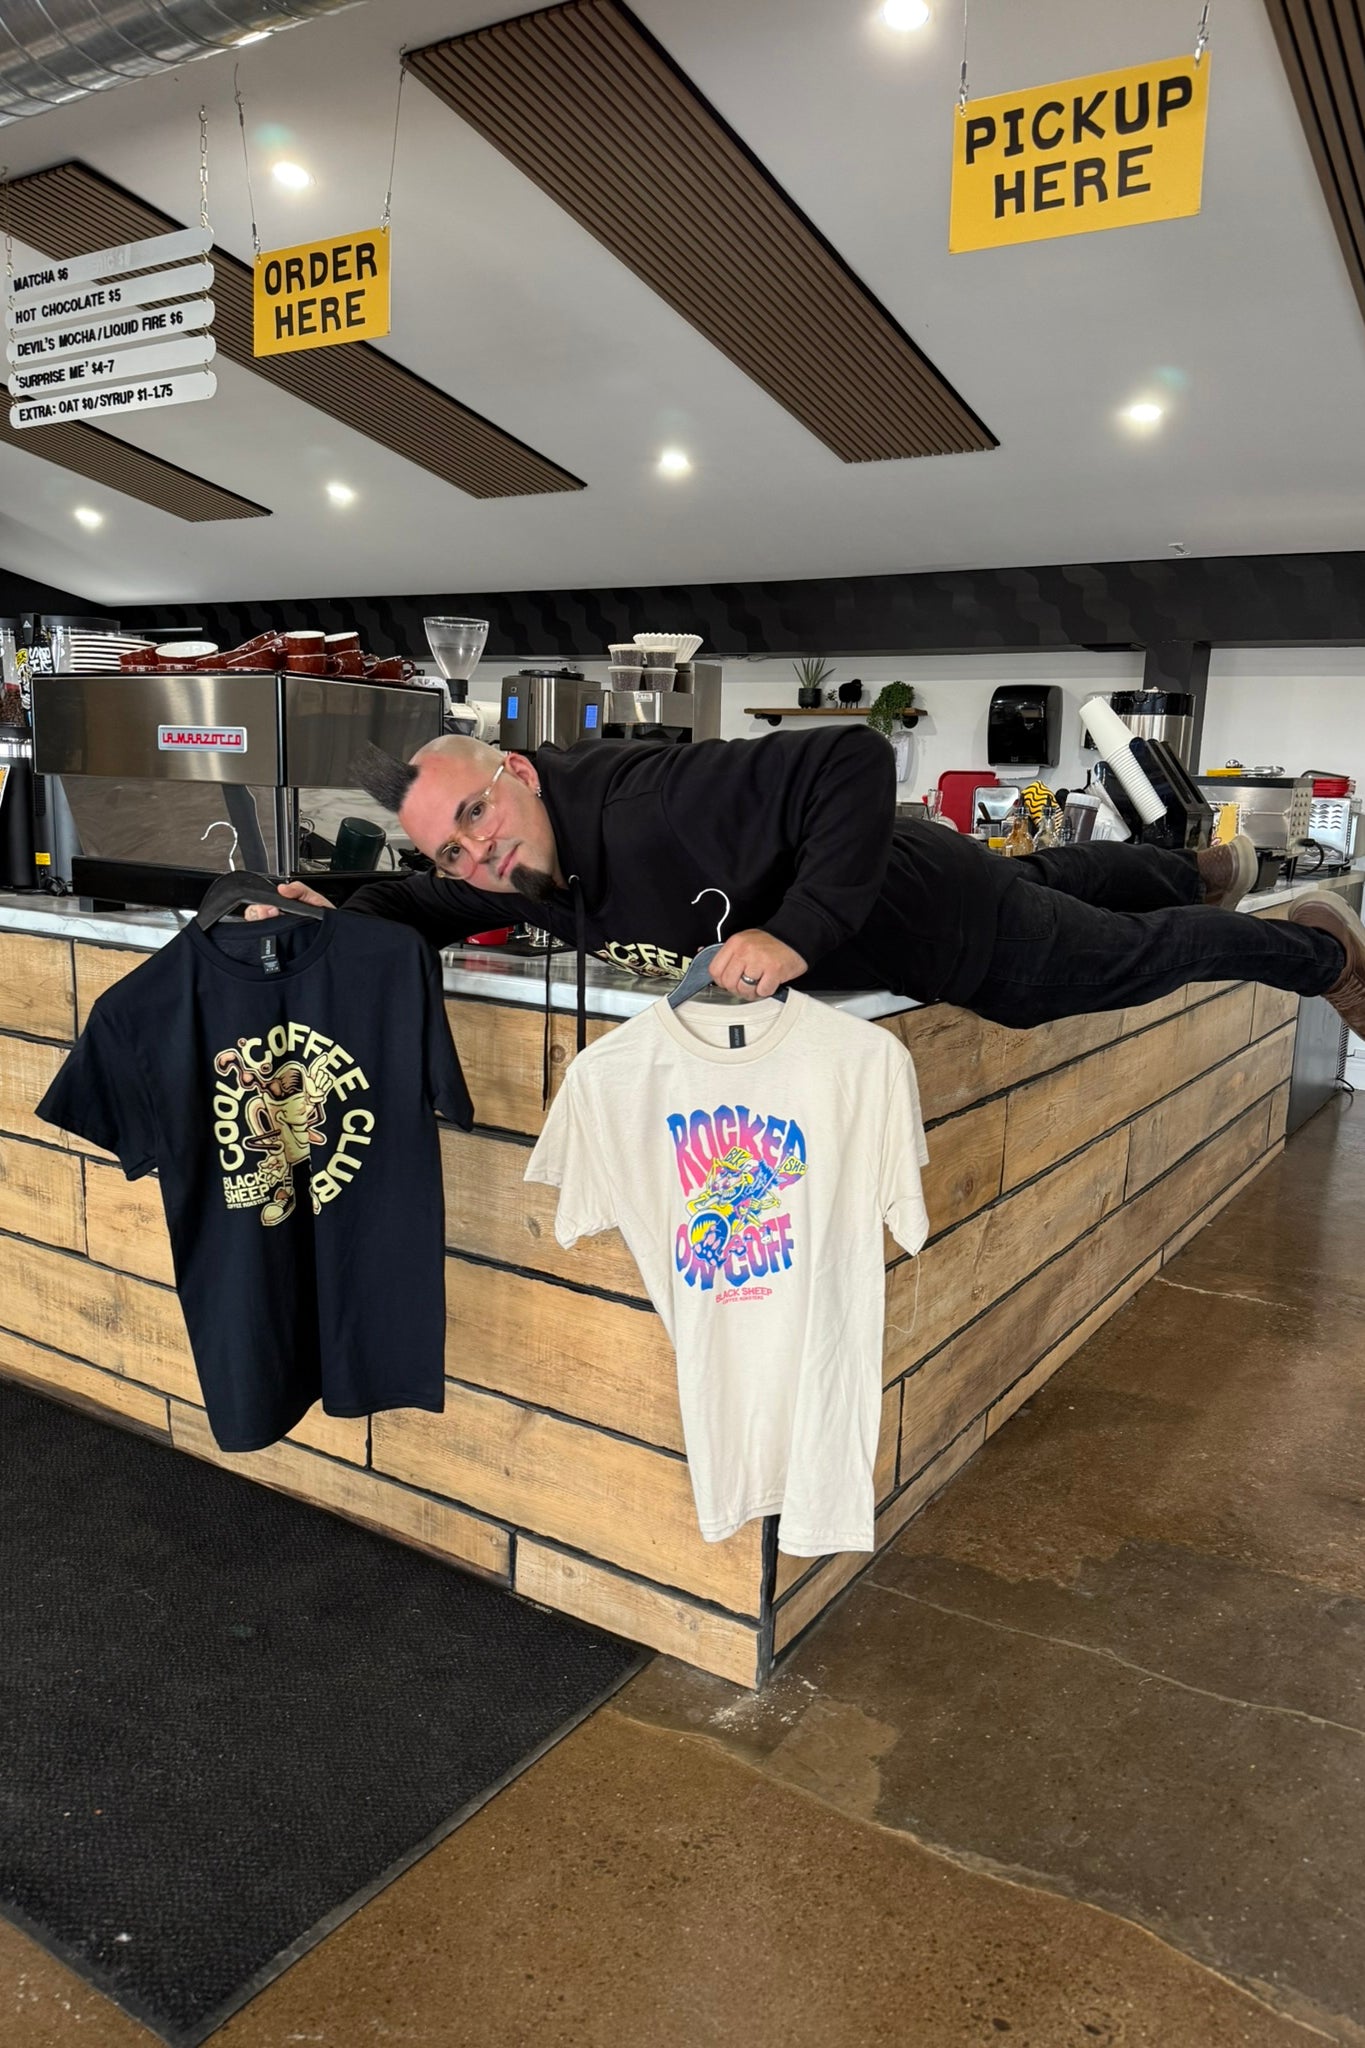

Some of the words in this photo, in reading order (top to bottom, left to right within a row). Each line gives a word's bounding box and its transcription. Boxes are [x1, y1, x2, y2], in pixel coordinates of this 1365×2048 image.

[965, 75, 1192, 165] PICKUP
[994, 144, 1153, 219] HERE
[14, 269, 55, 292] MATCHA
[57, 267, 69, 281] $6
[264, 242, 378, 296] ORDER
[15, 308, 37, 324] HOT
[41, 291, 105, 318] CHOCOLATE
[108, 288, 121, 302] $5
[275, 288, 366, 340] HERE
[17, 336, 56, 357] DEVIL'S
[142, 314, 167, 331] FIRE
[170, 311, 183, 326] $6
[91, 359, 115, 375] $4-7
[19, 403, 57, 422] EXTRA:
[59, 398, 80, 414] OAT
[213, 1080, 245, 1171] COOL
[242, 1021, 370, 1102] COFFEE
[311, 1108, 375, 1204] CLUB
[666, 1104, 807, 1198] ROCKED
[222, 1172, 267, 1190] BLACK
[224, 1183, 270, 1204] SHEEP
[741, 1286, 773, 1296] SHEEP
